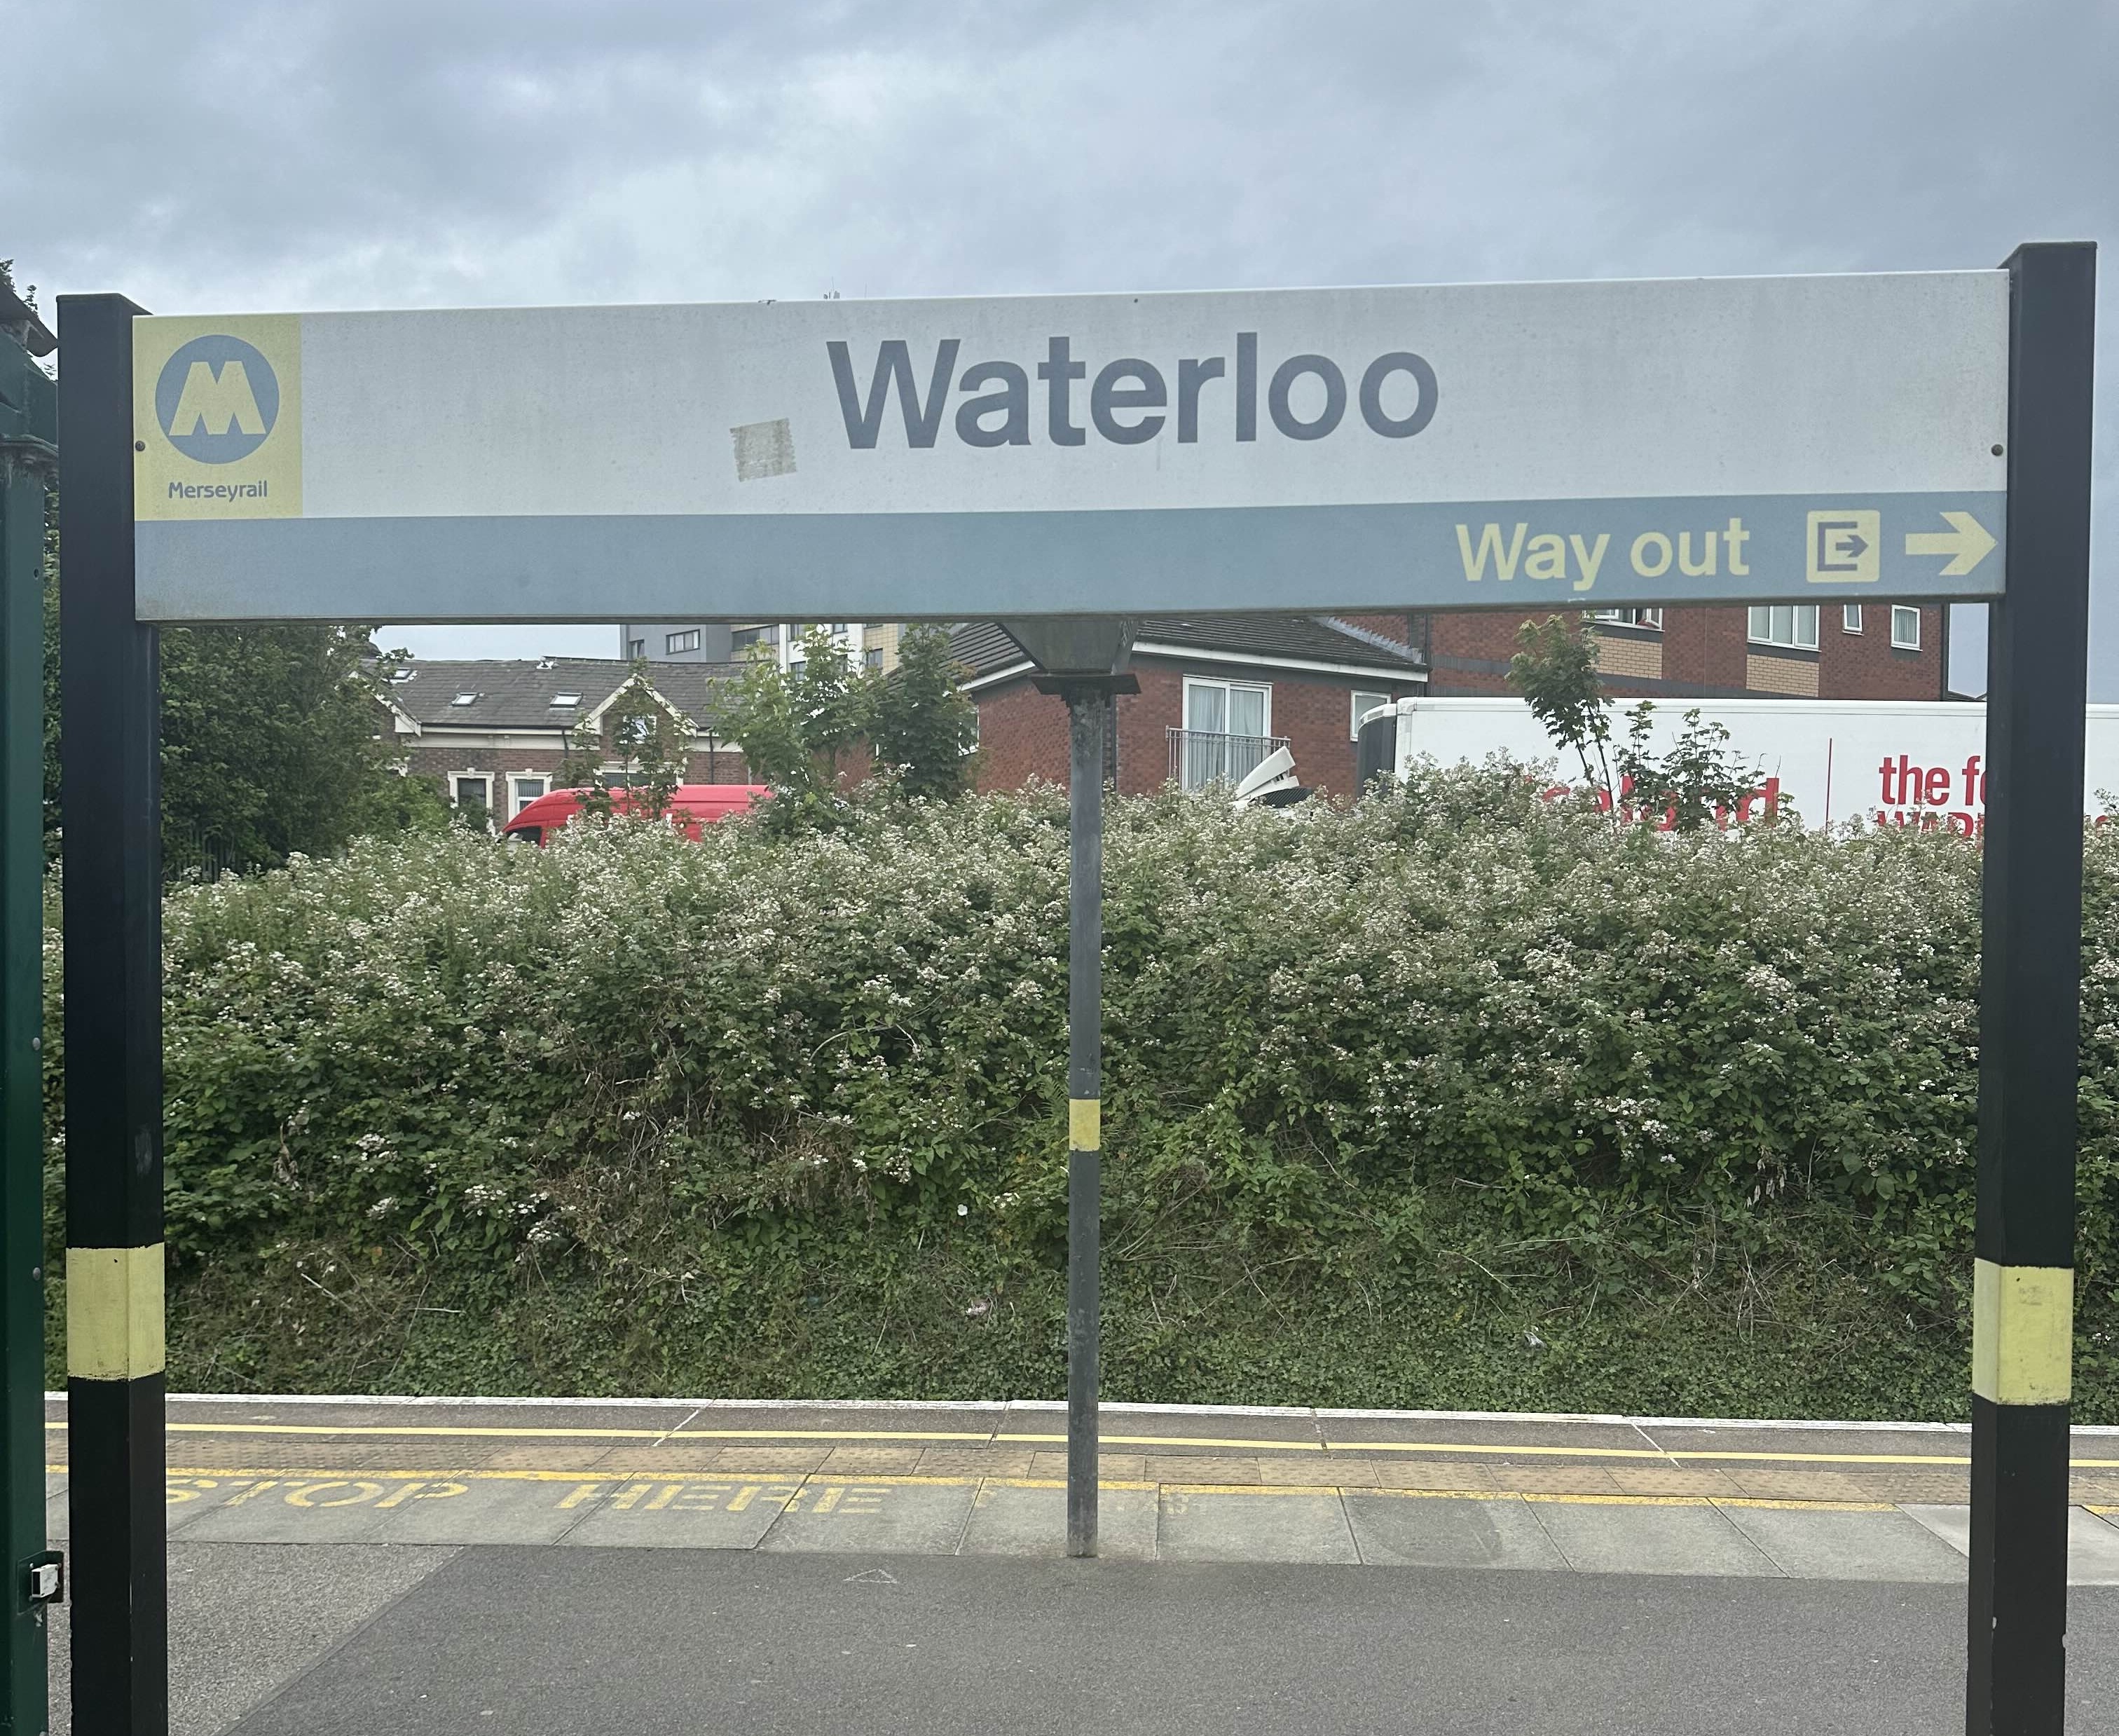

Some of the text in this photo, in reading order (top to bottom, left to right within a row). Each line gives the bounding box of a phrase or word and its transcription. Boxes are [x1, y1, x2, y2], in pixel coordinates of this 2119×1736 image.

[827, 332, 1439, 449] Waterloo
[168, 481, 268, 502] Merseyrail
[1455, 517, 1750, 591] Way out
[1879, 755, 1950, 806] the
[554, 1484, 890, 1514] HERE
